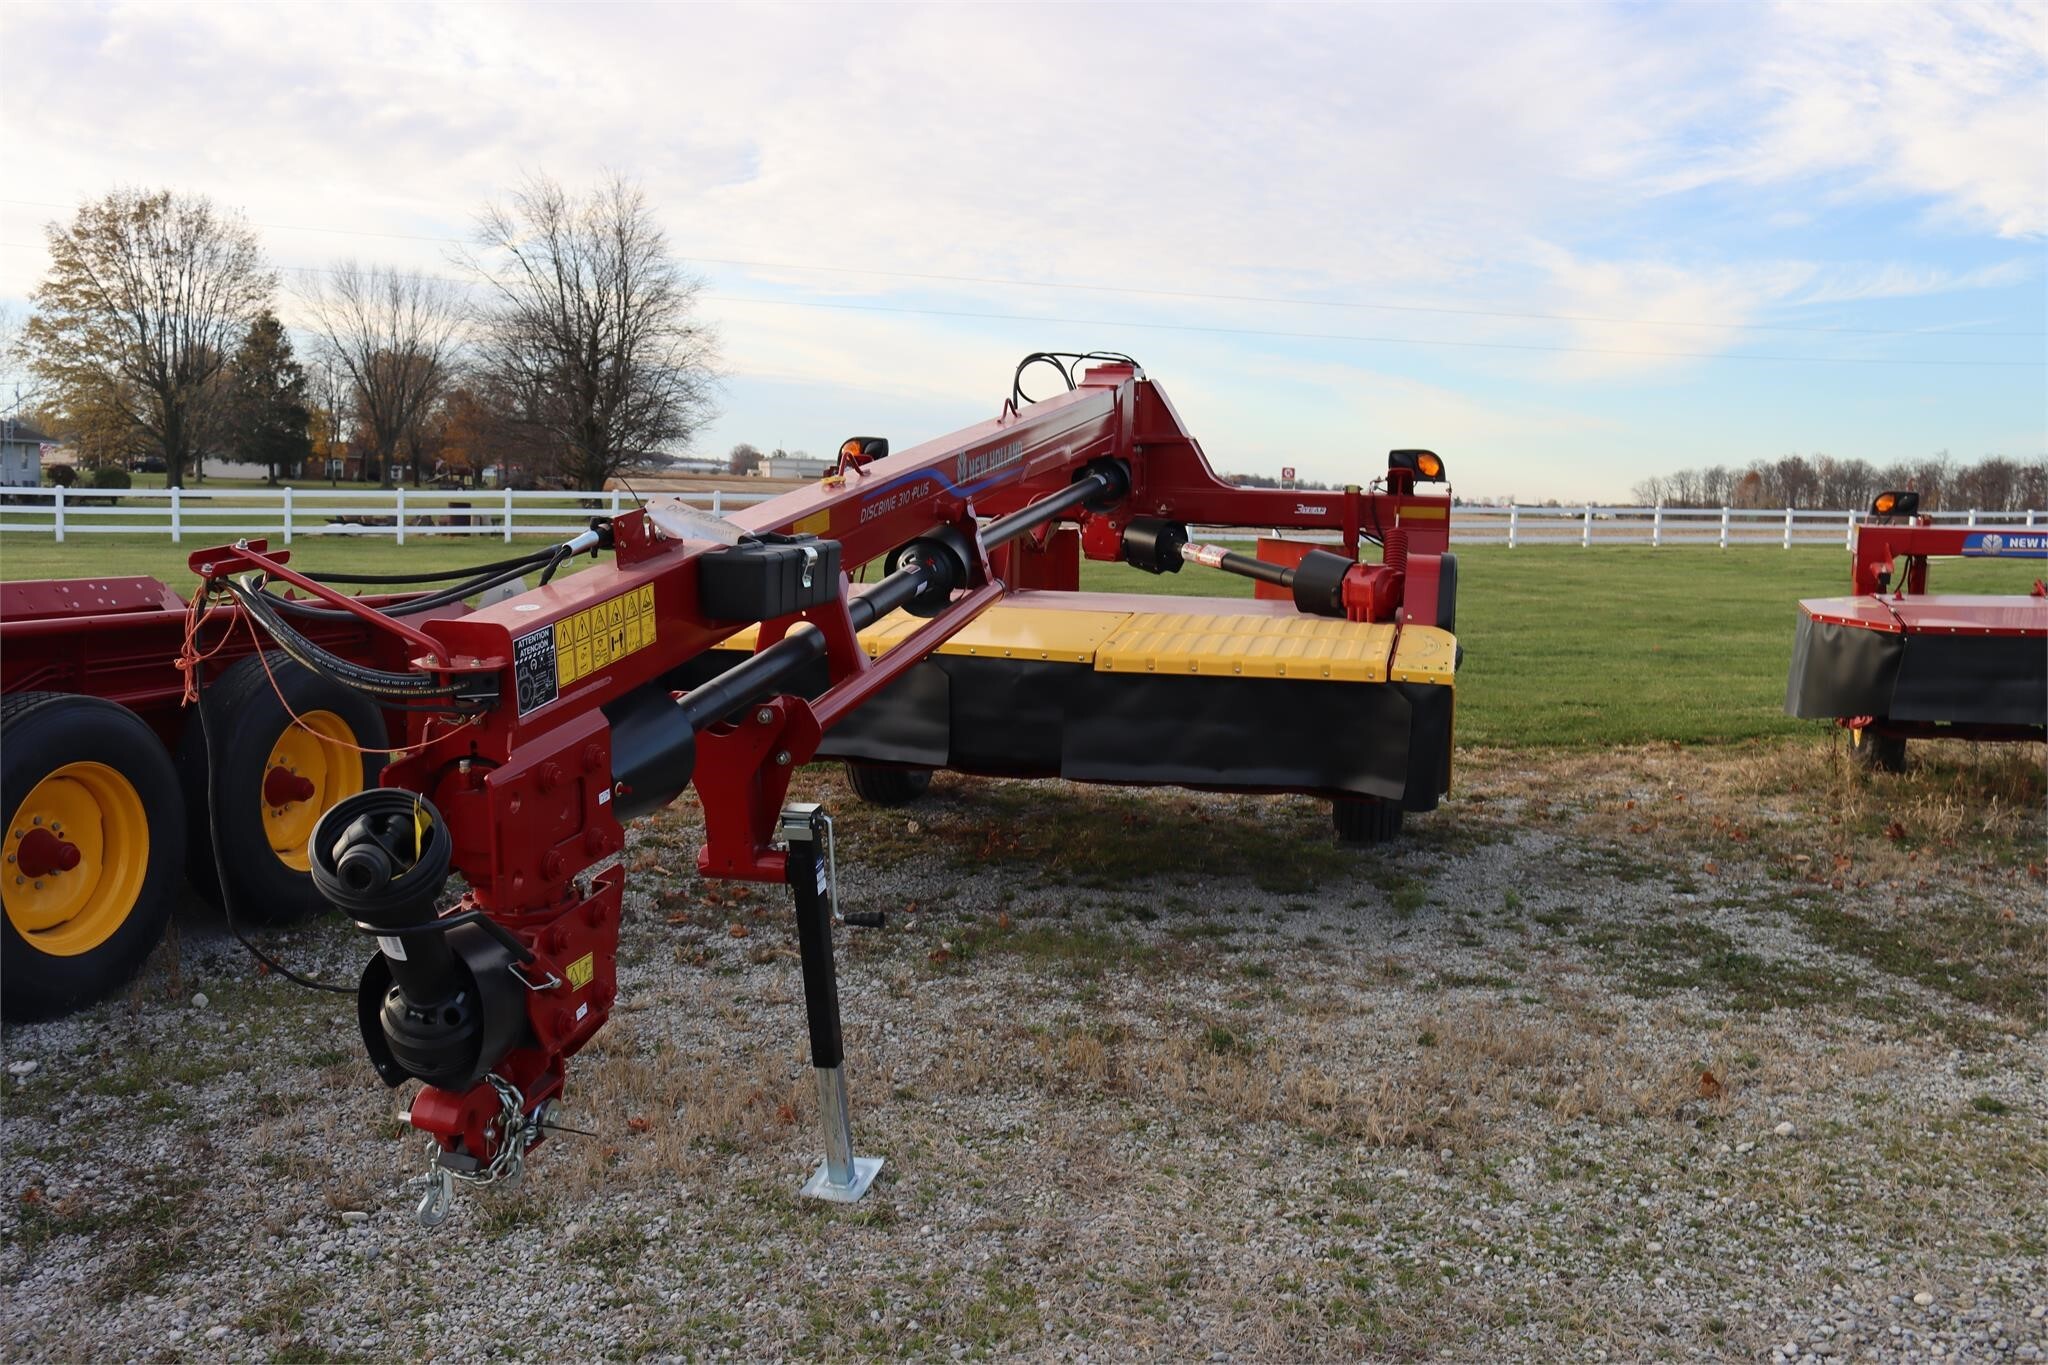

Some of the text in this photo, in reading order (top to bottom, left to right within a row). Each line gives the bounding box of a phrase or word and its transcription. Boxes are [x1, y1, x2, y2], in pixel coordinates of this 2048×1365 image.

[969, 441, 1022, 480] NEW HOLLAND
[860, 481, 930, 524] DISCBINE 310 PLUS
[2009, 537, 2038, 548] NEW
[518, 629, 550, 648] ATTENTION
